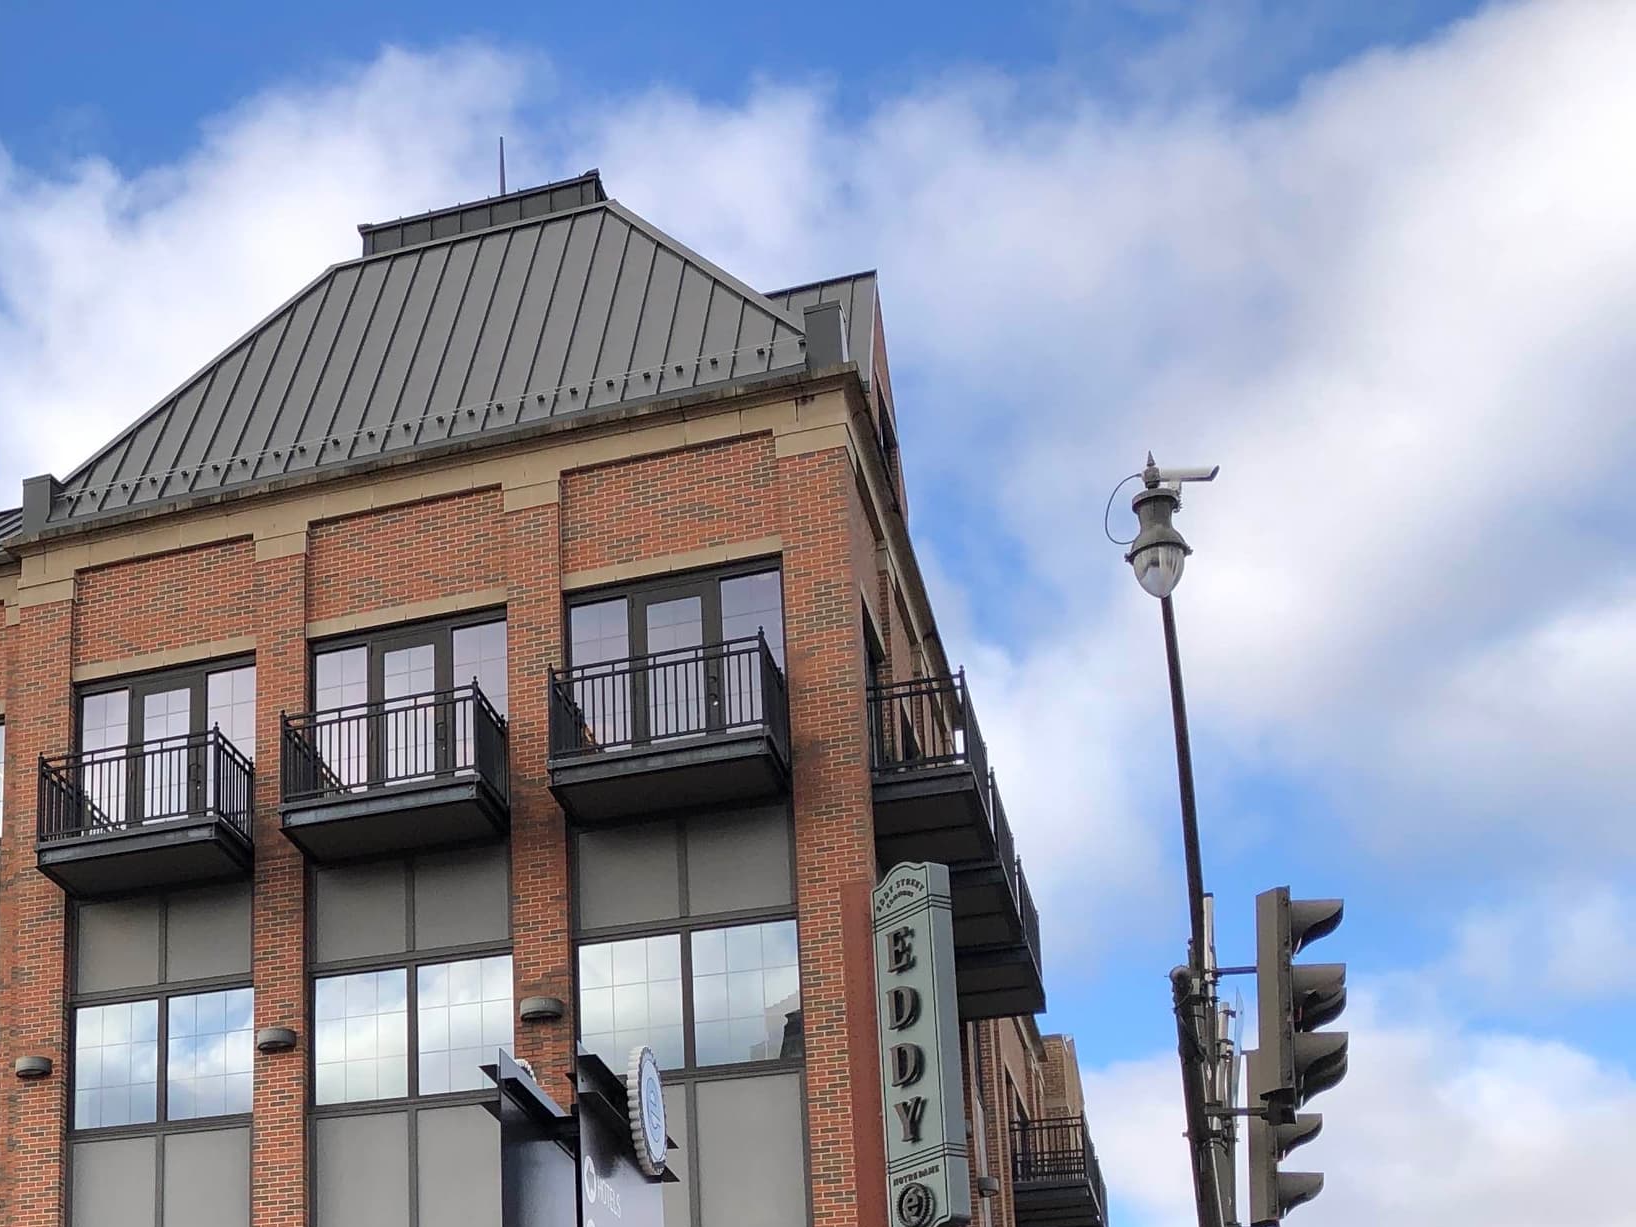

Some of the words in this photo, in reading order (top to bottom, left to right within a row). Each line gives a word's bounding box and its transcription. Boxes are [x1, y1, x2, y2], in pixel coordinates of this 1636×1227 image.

[895, 877, 925, 892] STREET
[885, 925, 927, 1143] EDDY
[597, 1174, 622, 1219] HOTELS
